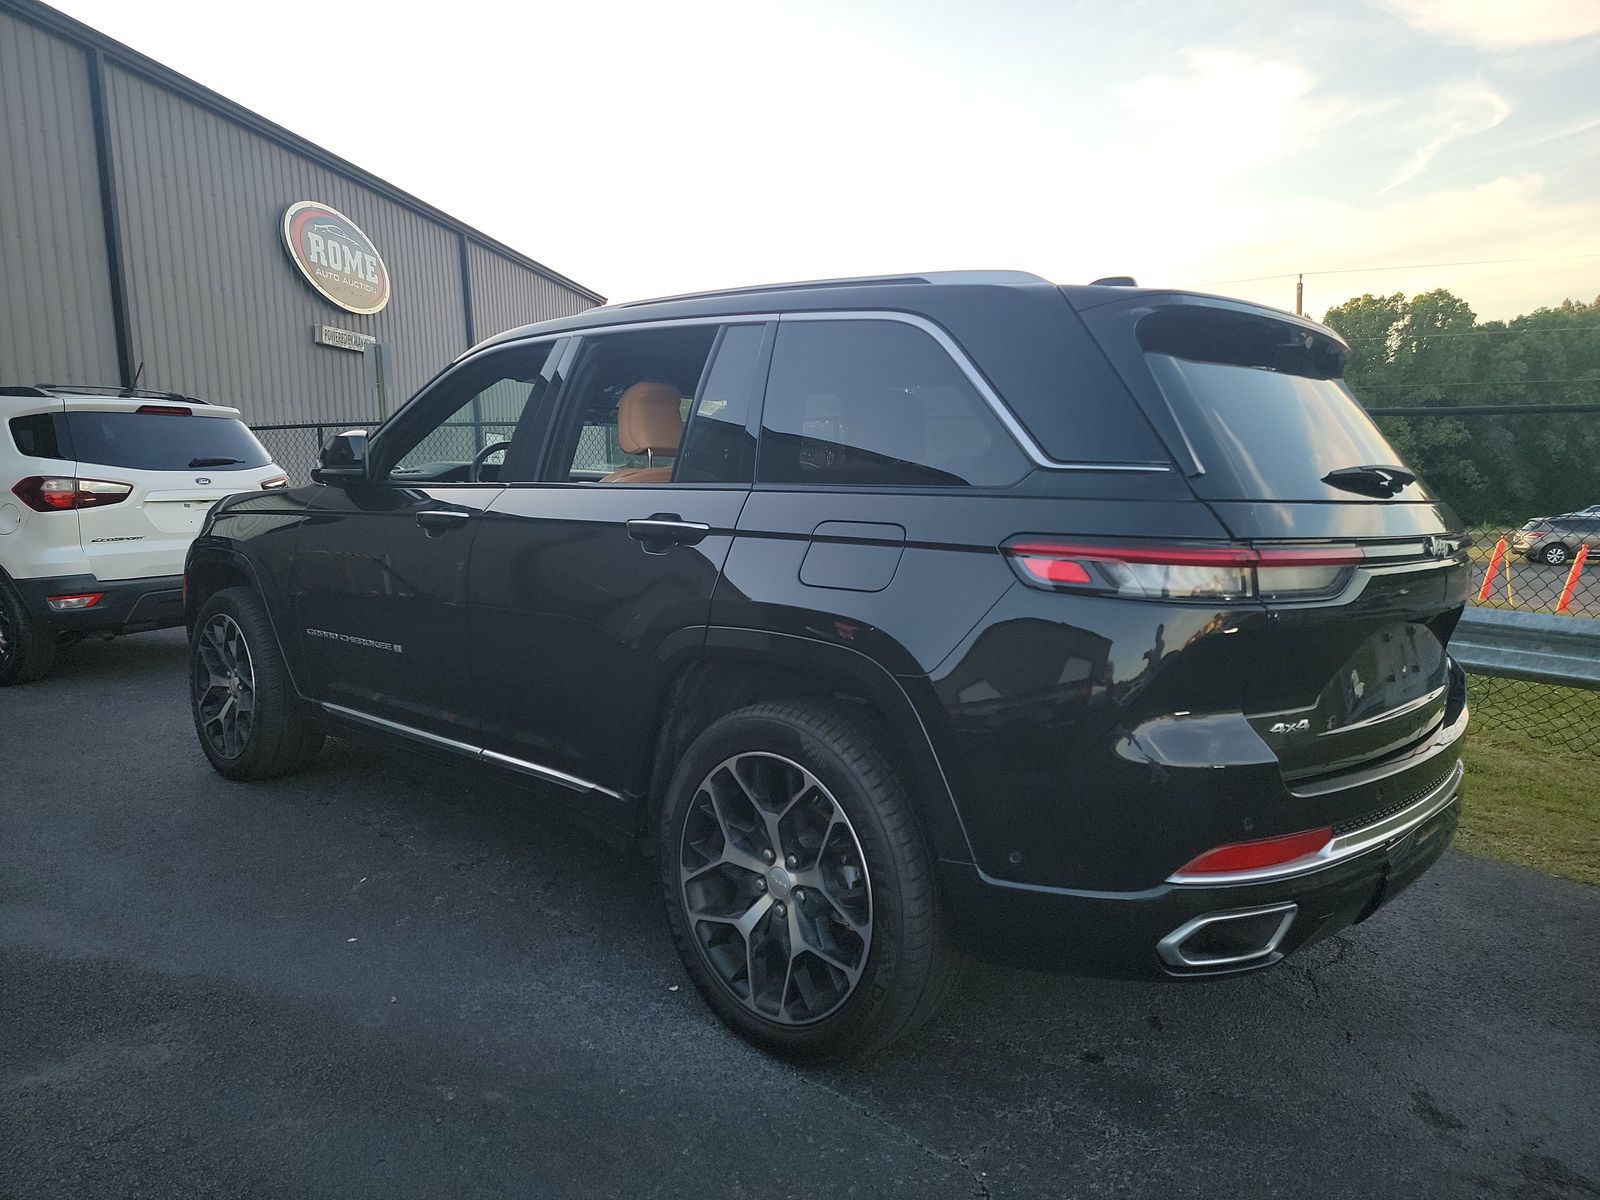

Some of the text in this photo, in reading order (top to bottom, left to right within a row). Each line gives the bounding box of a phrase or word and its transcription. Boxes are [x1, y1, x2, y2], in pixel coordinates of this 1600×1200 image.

[308, 232, 378, 284] ROME
[316, 268, 377, 294] AUTO AUCTION
[339, 634, 393, 651] CHEROKEE
[1269, 718, 1311, 733] 4x4
